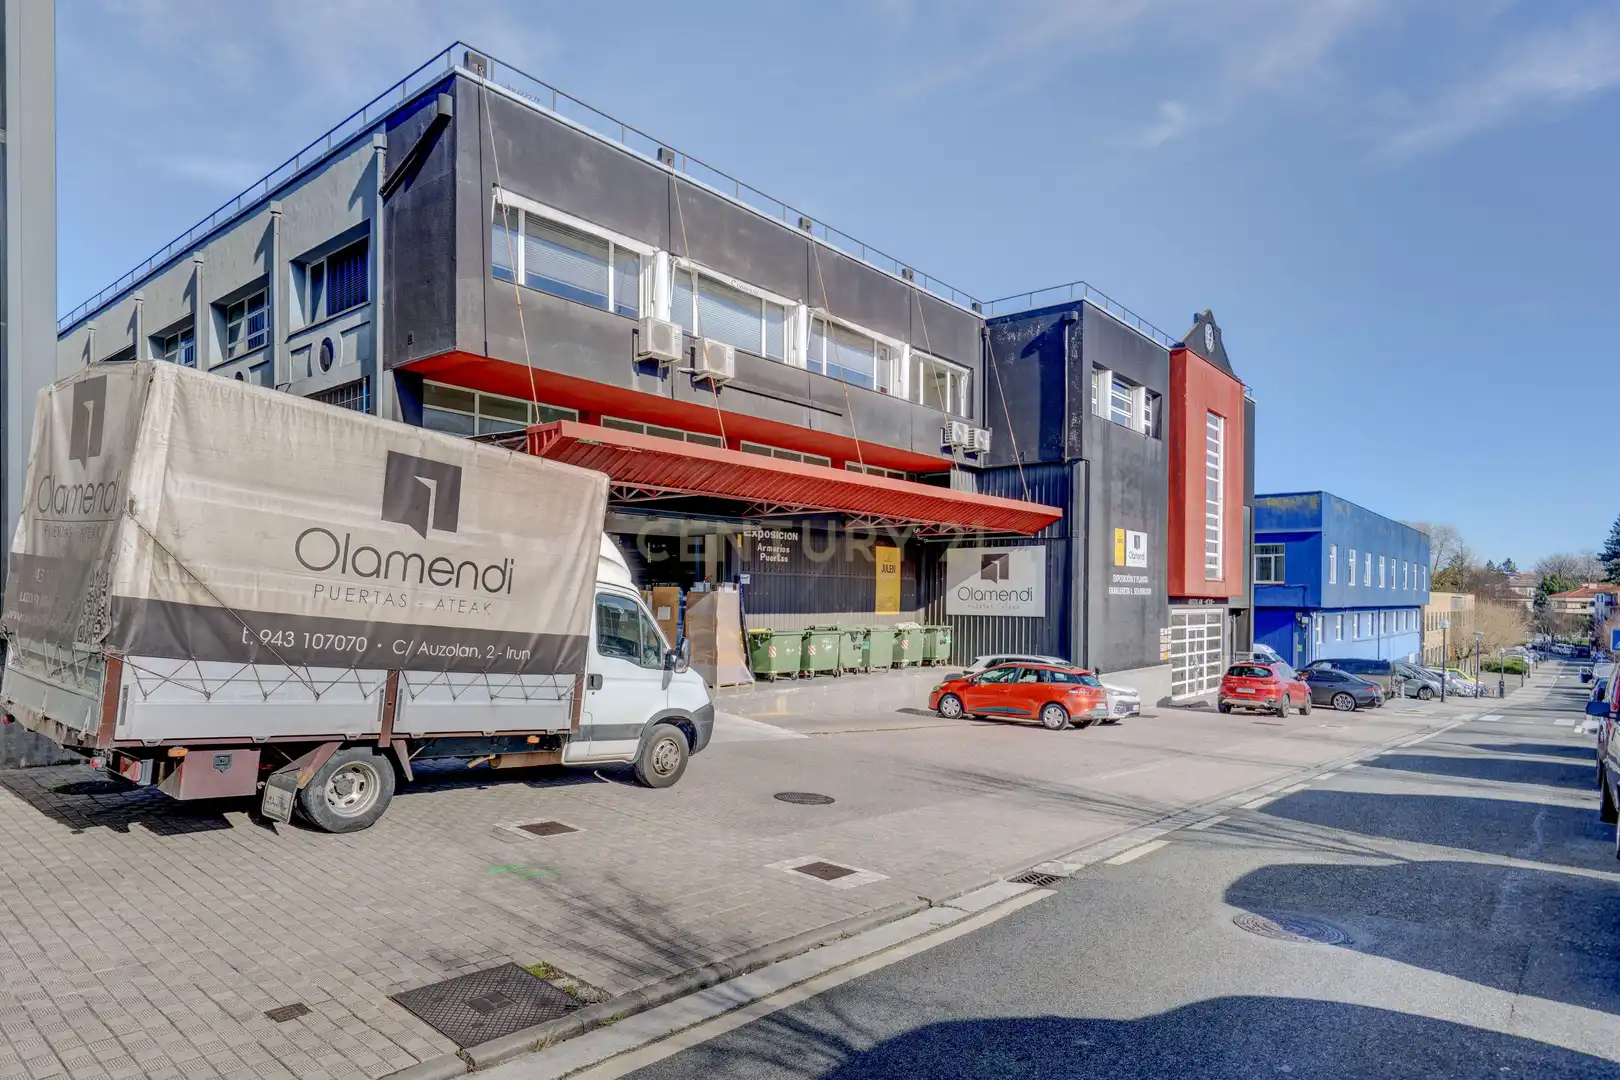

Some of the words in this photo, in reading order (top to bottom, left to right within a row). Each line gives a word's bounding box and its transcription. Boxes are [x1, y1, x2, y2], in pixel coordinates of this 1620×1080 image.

[37, 470, 121, 515] Olamendi
[295, 527, 515, 595] Olamendi
[757, 542, 791, 554] Armarios
[760, 552, 789, 563] Puertas
[313, 583, 408, 608] PUERTAS
[434, 598, 492, 616] ATEAK
[957, 586, 1033, 602] Olamendi
[241, 626, 253, 645] t.
[259, 629, 295, 647] 943
[303, 632, 368, 652] 107070
[392, 639, 411, 656] C/
[417, 643, 482, 660] Auzolan,
[486, 645, 495, 659] 2
[506, 646, 531, 661] Irun
